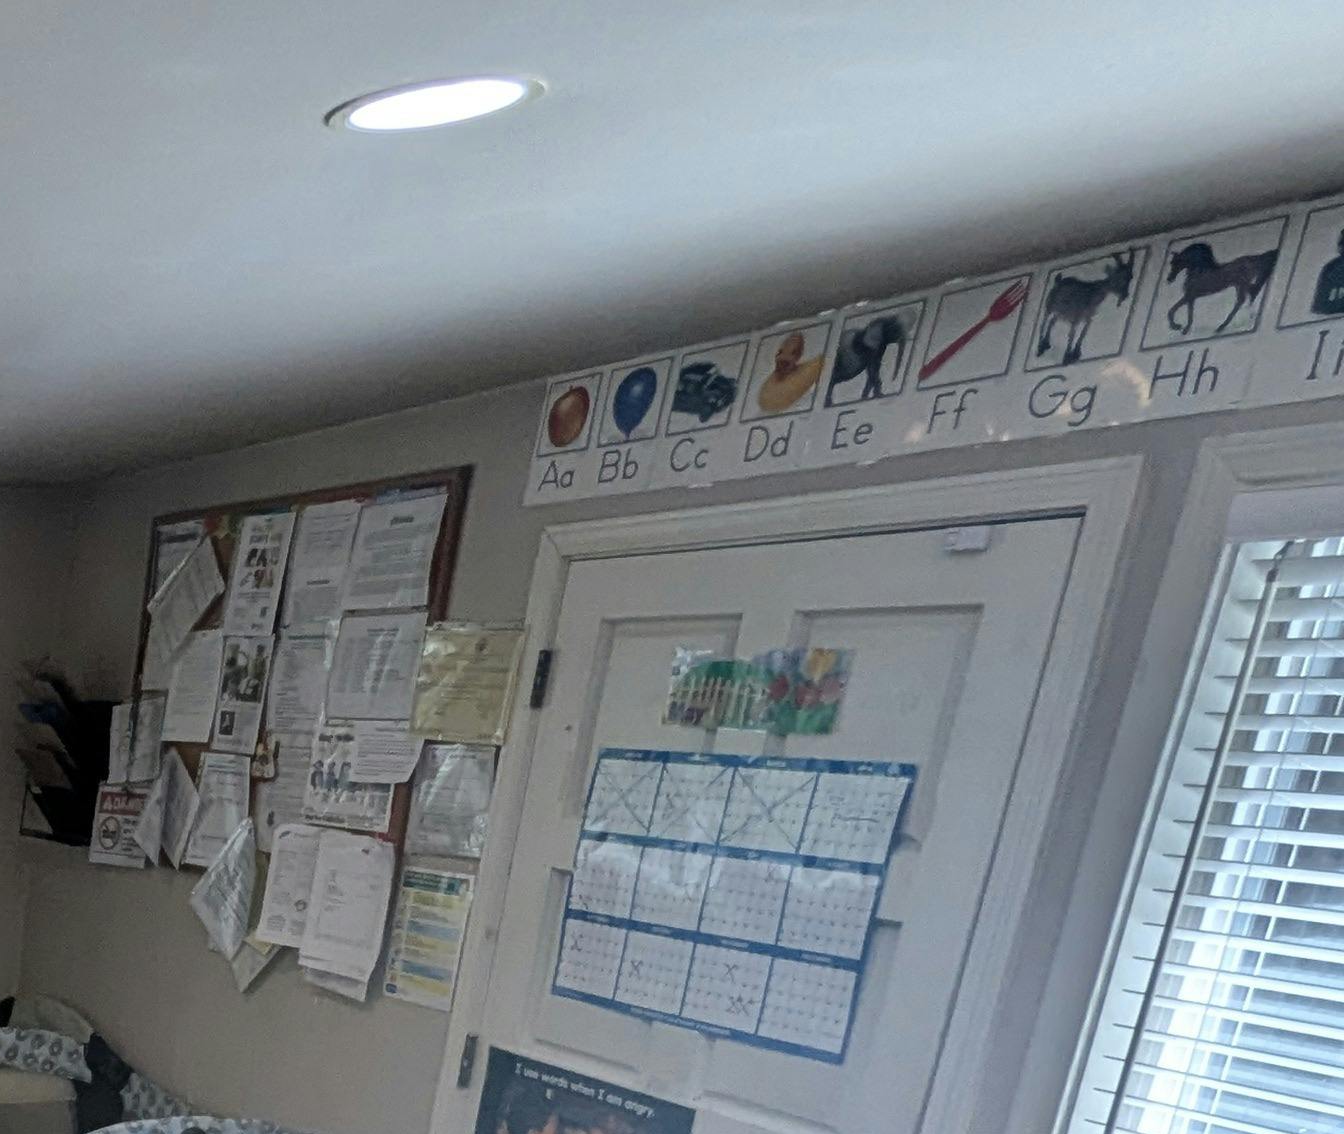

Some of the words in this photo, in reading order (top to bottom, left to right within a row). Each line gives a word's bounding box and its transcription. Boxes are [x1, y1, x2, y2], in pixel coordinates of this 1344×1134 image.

[537, 460, 576, 491] Aa
[598, 449, 639, 484] Bb
[669, 437, 709, 473] Cc
[743, 420, 794, 462] Dd
[830, 409, 874, 450] Ee
[926, 388, 979, 434] Ff
[1028, 373, 1099, 427] Gg
[1149, 347, 1220, 400] Hh
